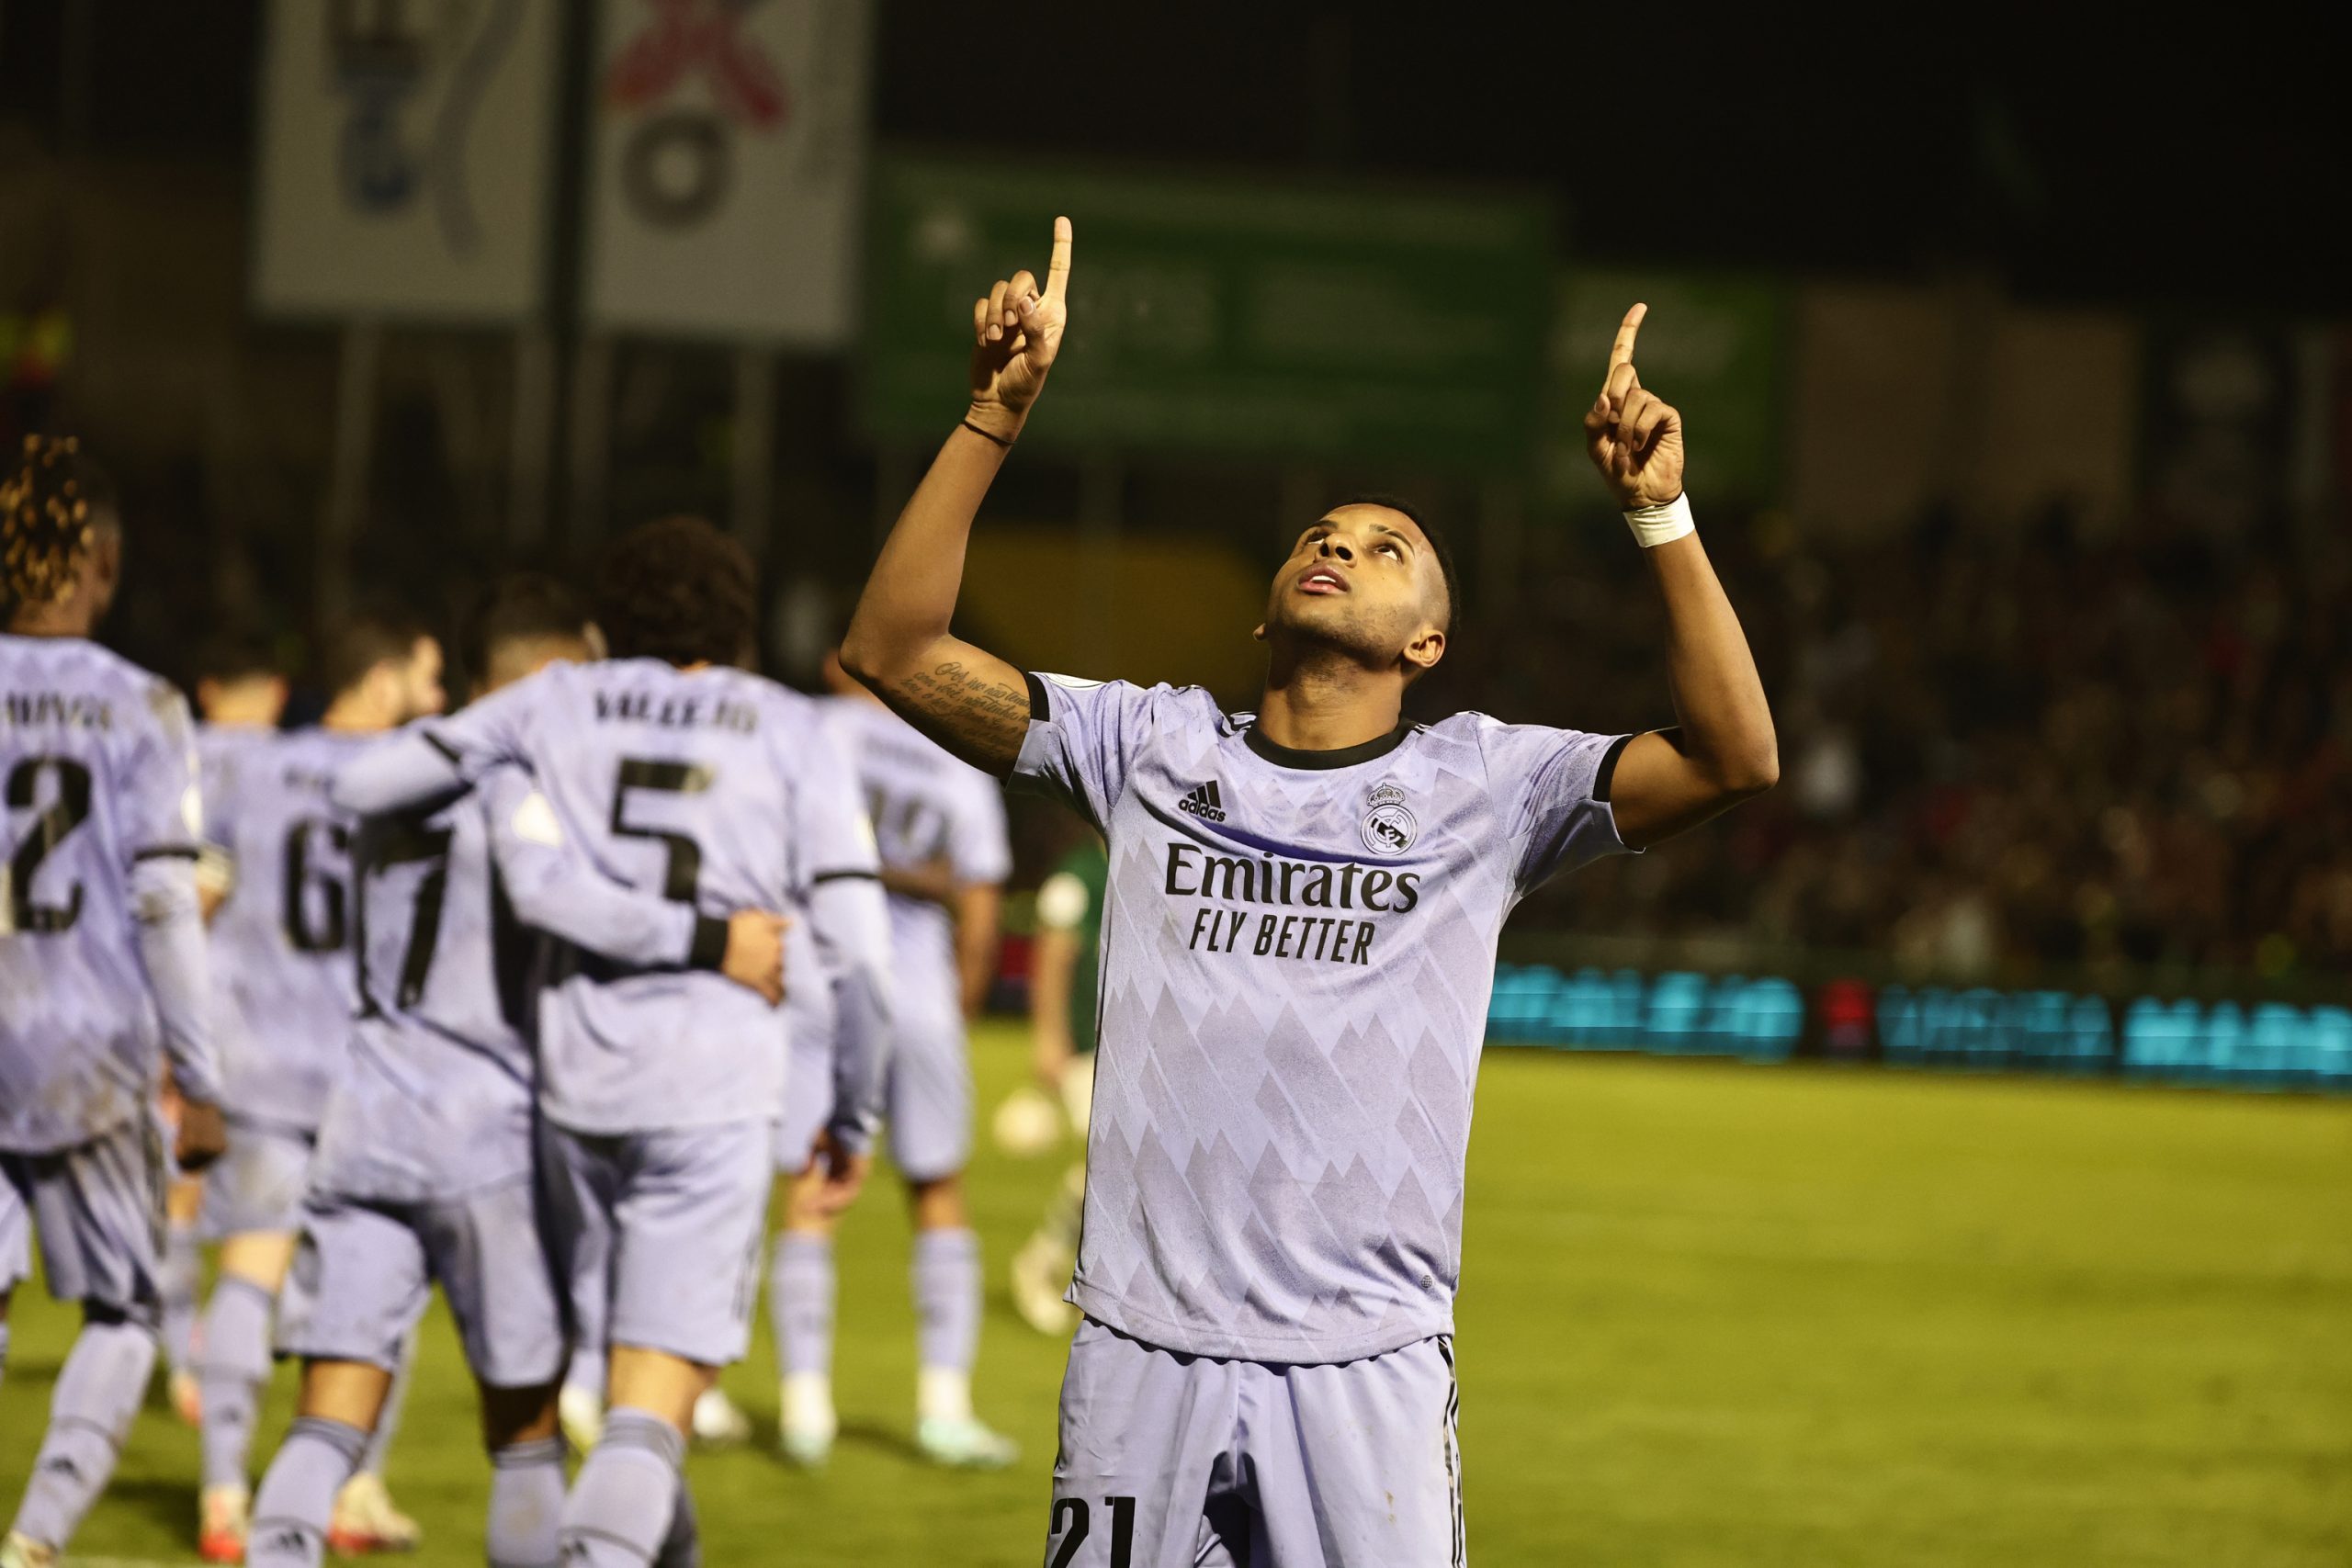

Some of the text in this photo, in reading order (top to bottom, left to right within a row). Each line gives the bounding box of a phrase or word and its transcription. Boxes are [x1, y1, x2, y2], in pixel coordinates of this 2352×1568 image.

[610, 755, 718, 904] 5
[1178, 798, 1226, 822] adidas
[284, 820, 348, 953] 6
[1165, 842, 1420, 914] Emirates
[1189, 908, 1375, 965] FLY BETTER
[1050, 1496, 1136, 1568] 21
